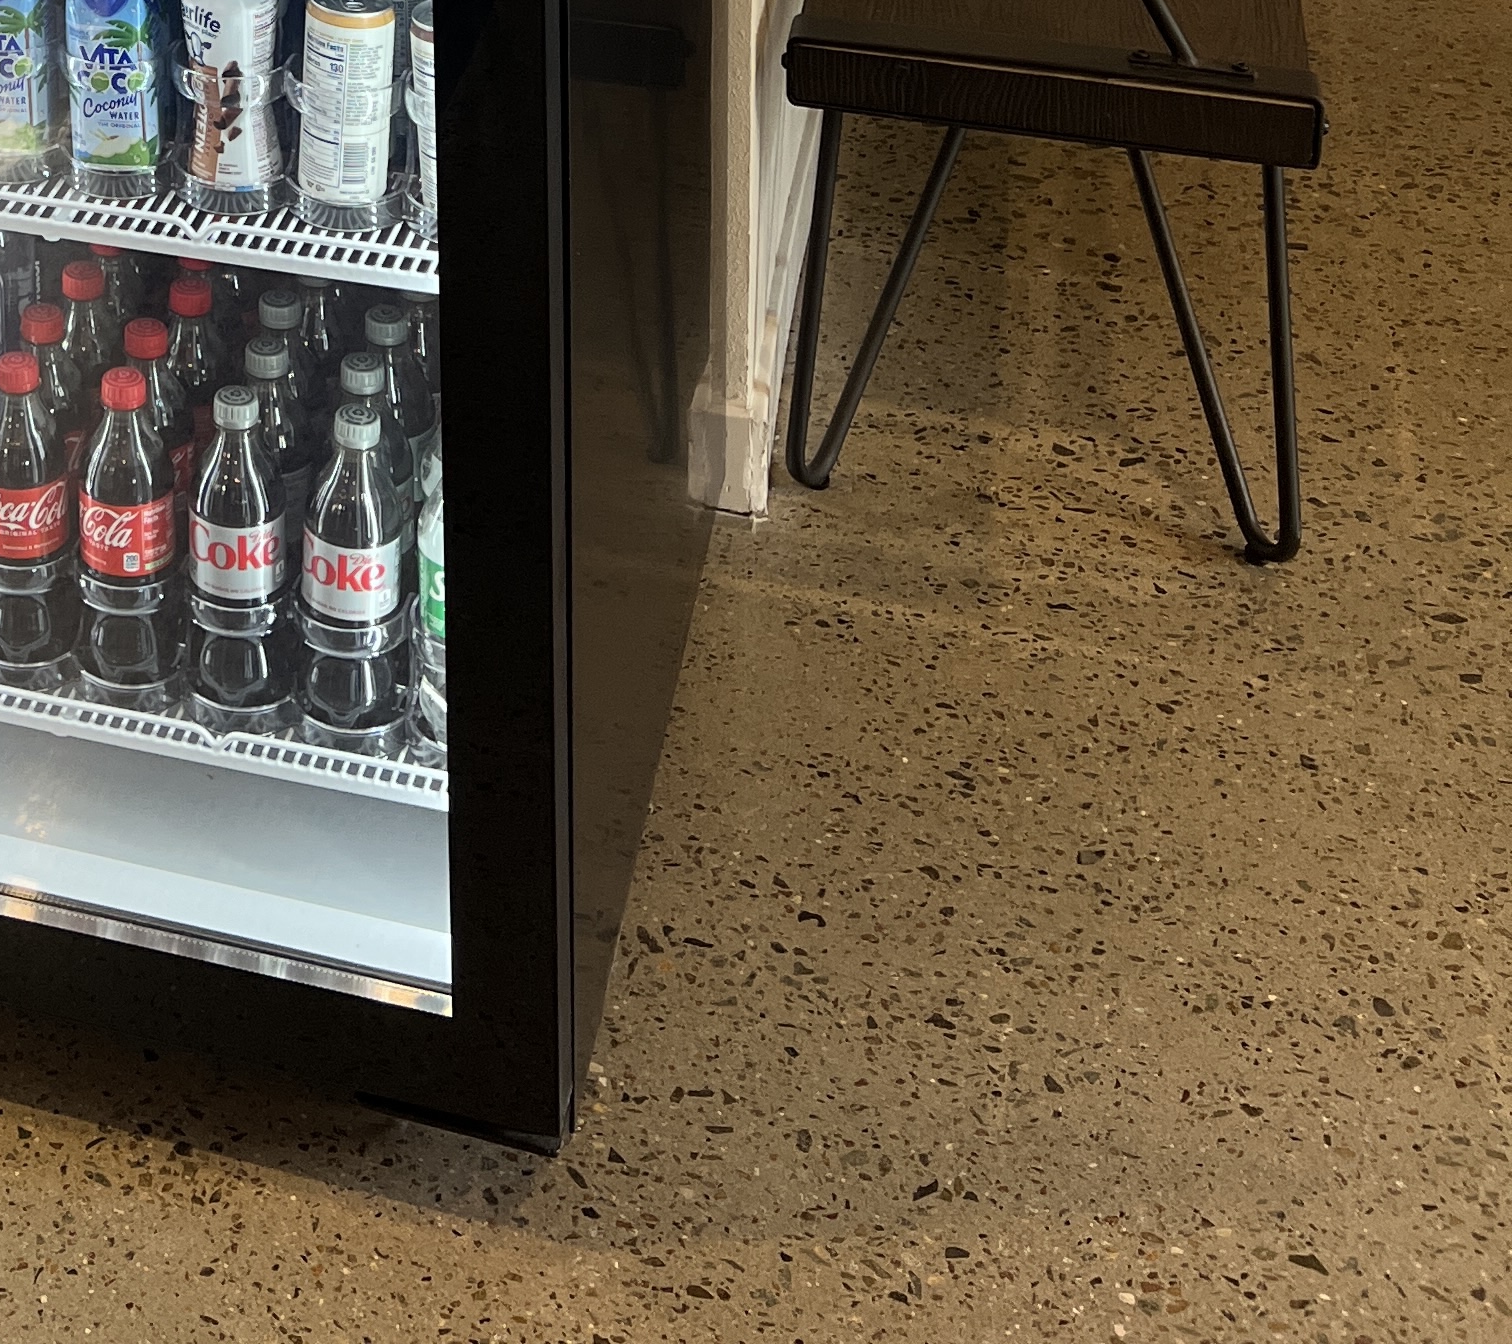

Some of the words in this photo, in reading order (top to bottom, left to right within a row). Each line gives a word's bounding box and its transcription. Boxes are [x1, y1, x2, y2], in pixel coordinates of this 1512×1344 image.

[79, 43, 138, 71] VITA
[83, 91, 139, 119] Coconut
[108, 111, 141, 122] WATER
[40, 520, 62, 534] TASTE
[189, 519, 281, 571] Coke
[349, 552, 380, 567] Diet
